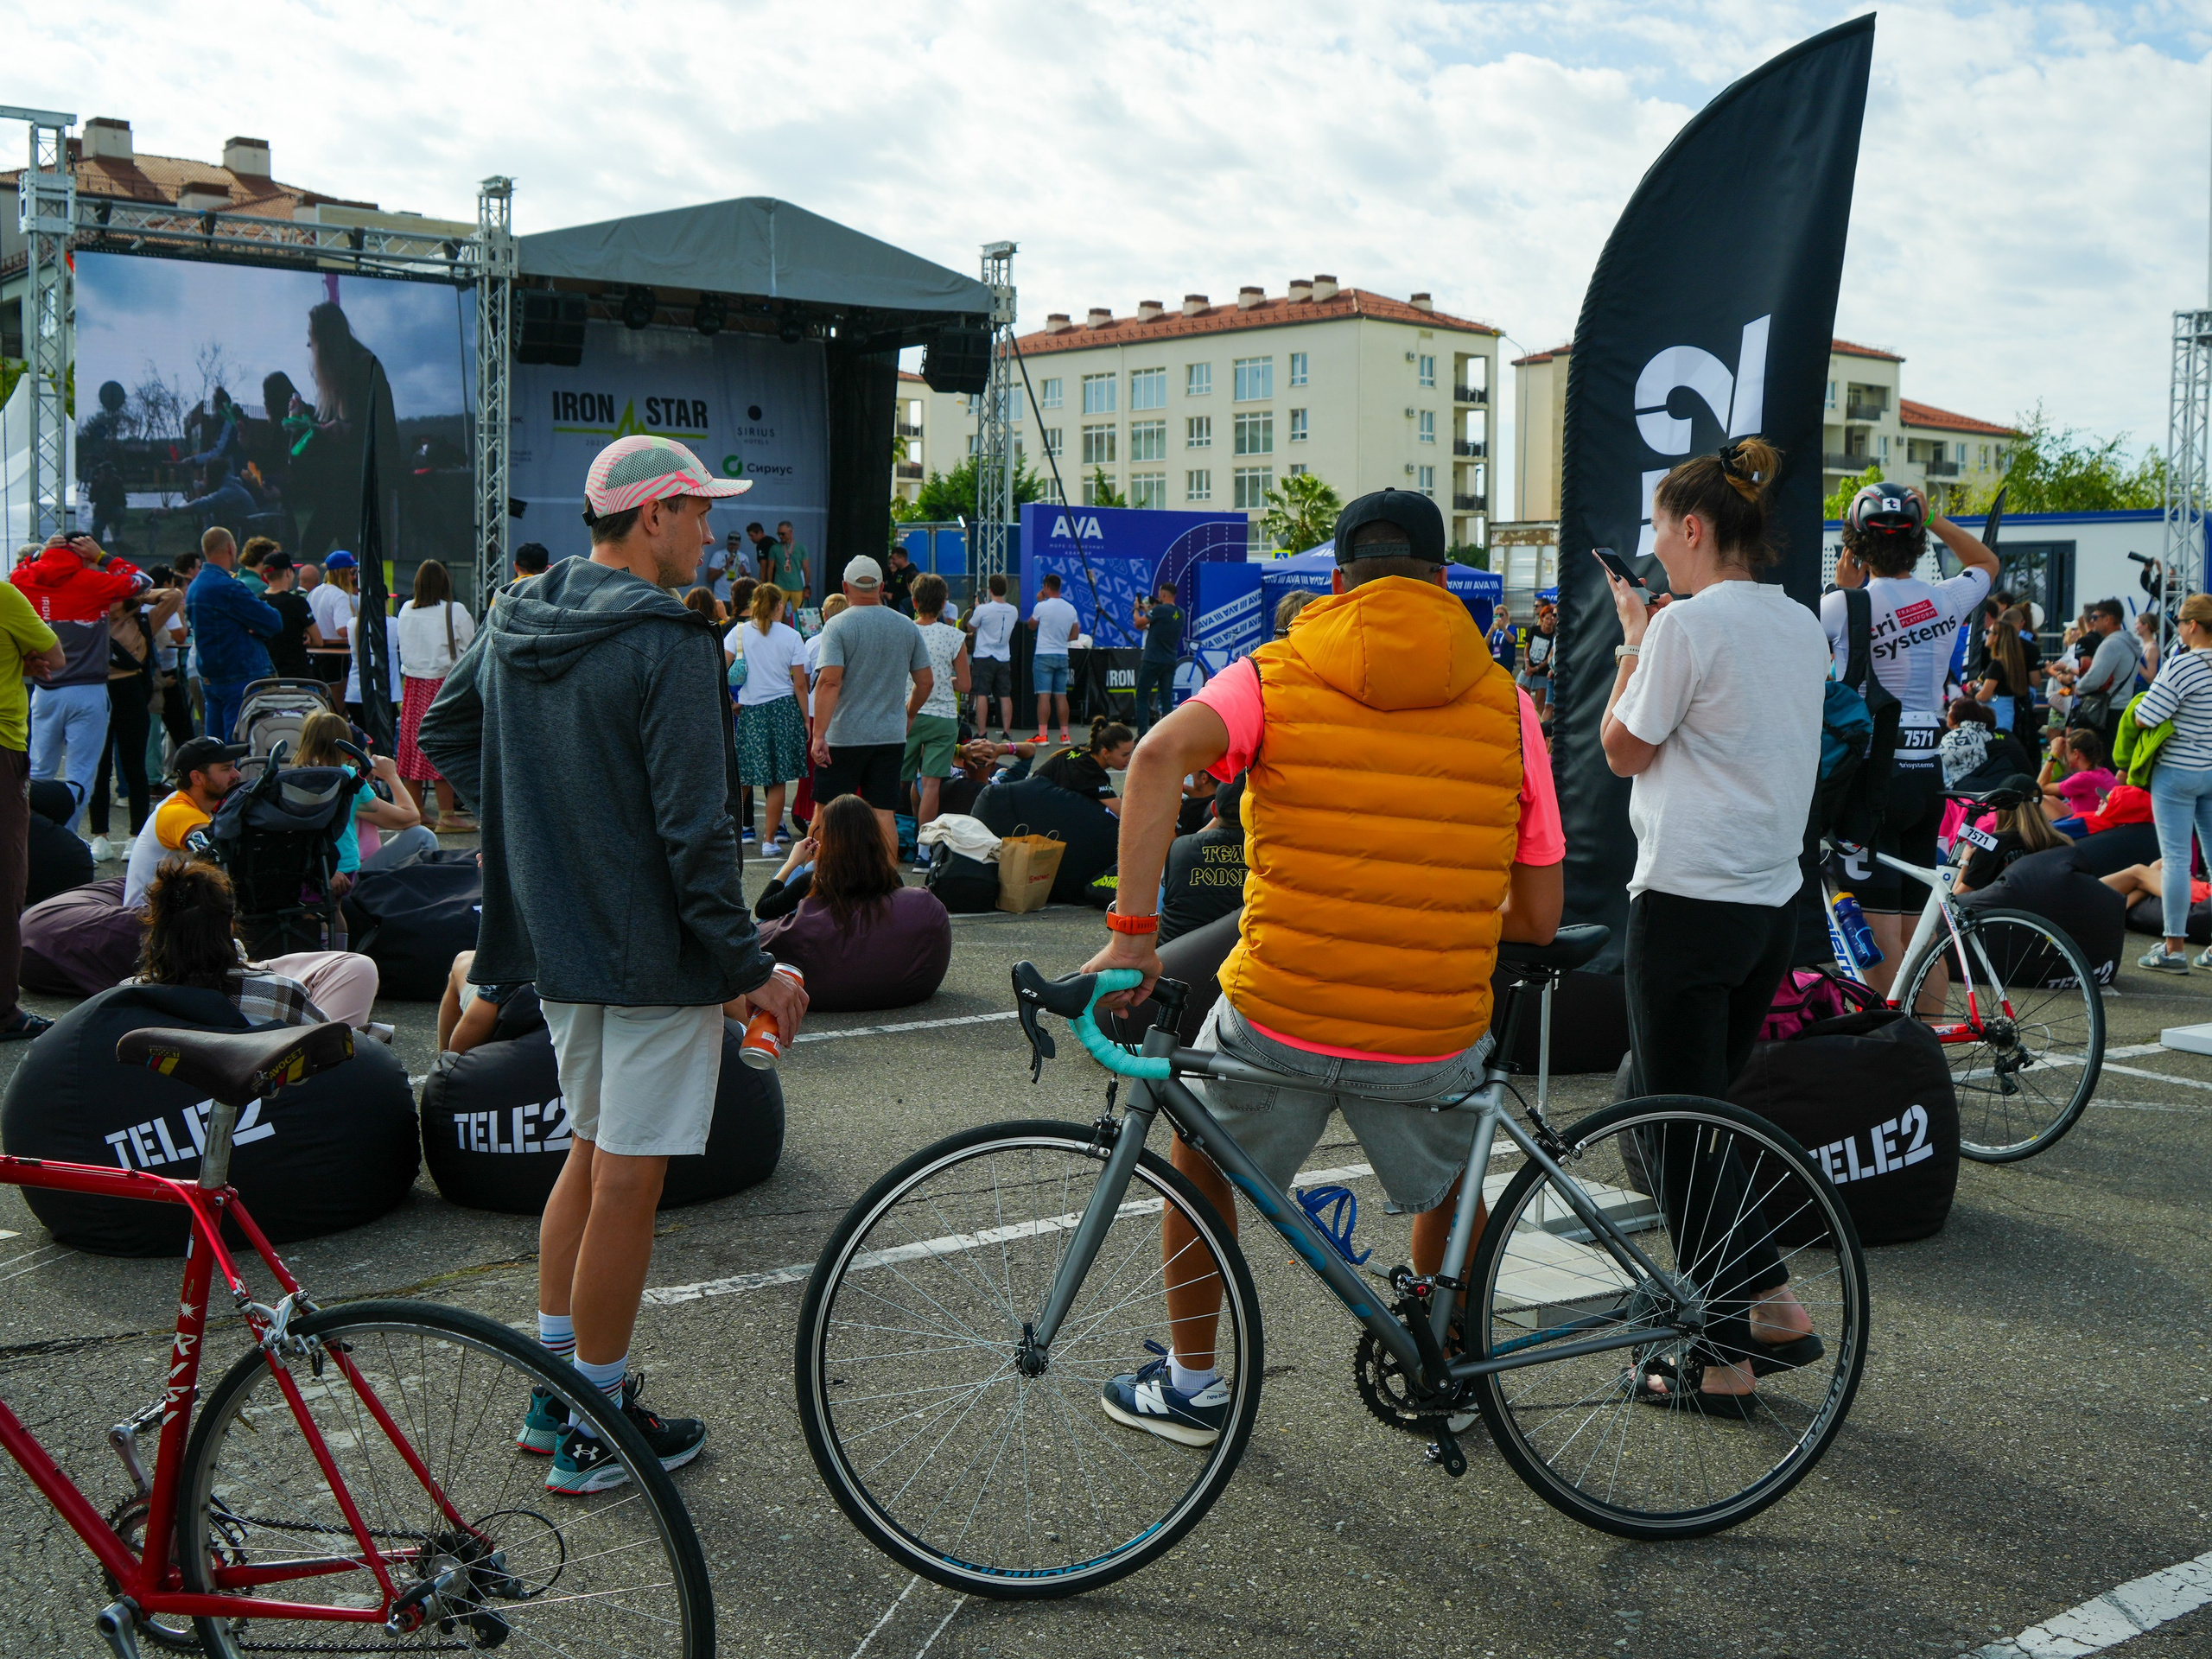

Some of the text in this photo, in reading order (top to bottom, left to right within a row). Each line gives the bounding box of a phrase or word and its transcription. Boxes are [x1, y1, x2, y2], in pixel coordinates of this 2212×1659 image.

[552, 391, 708, 429] IRON STAR
[737, 427, 775, 438] SIRIUS
[747, 462, 793, 476] Сириус
[1051, 515, 1103, 539] AVA
[1473, 581, 1491, 589] AVA
[1897, 601, 1929, 617] TRAINING
[1901, 610, 1936, 626] PLATFORM
[1872, 615, 1957, 661] systems
[1106, 669, 1135, 687] IRON
[1904, 730, 1934, 747] 7571
[1898, 761, 1935, 770] trisystems
[1967, 828, 1990, 846] 7571
[1202, 844, 1245, 863] TEA
[1021, 988, 1039, 999] R3
[149, 1048, 180, 1058] AVOCET
[269, 1047, 302, 1080] AVOCET
[454, 1096, 573, 1154] TELE2
